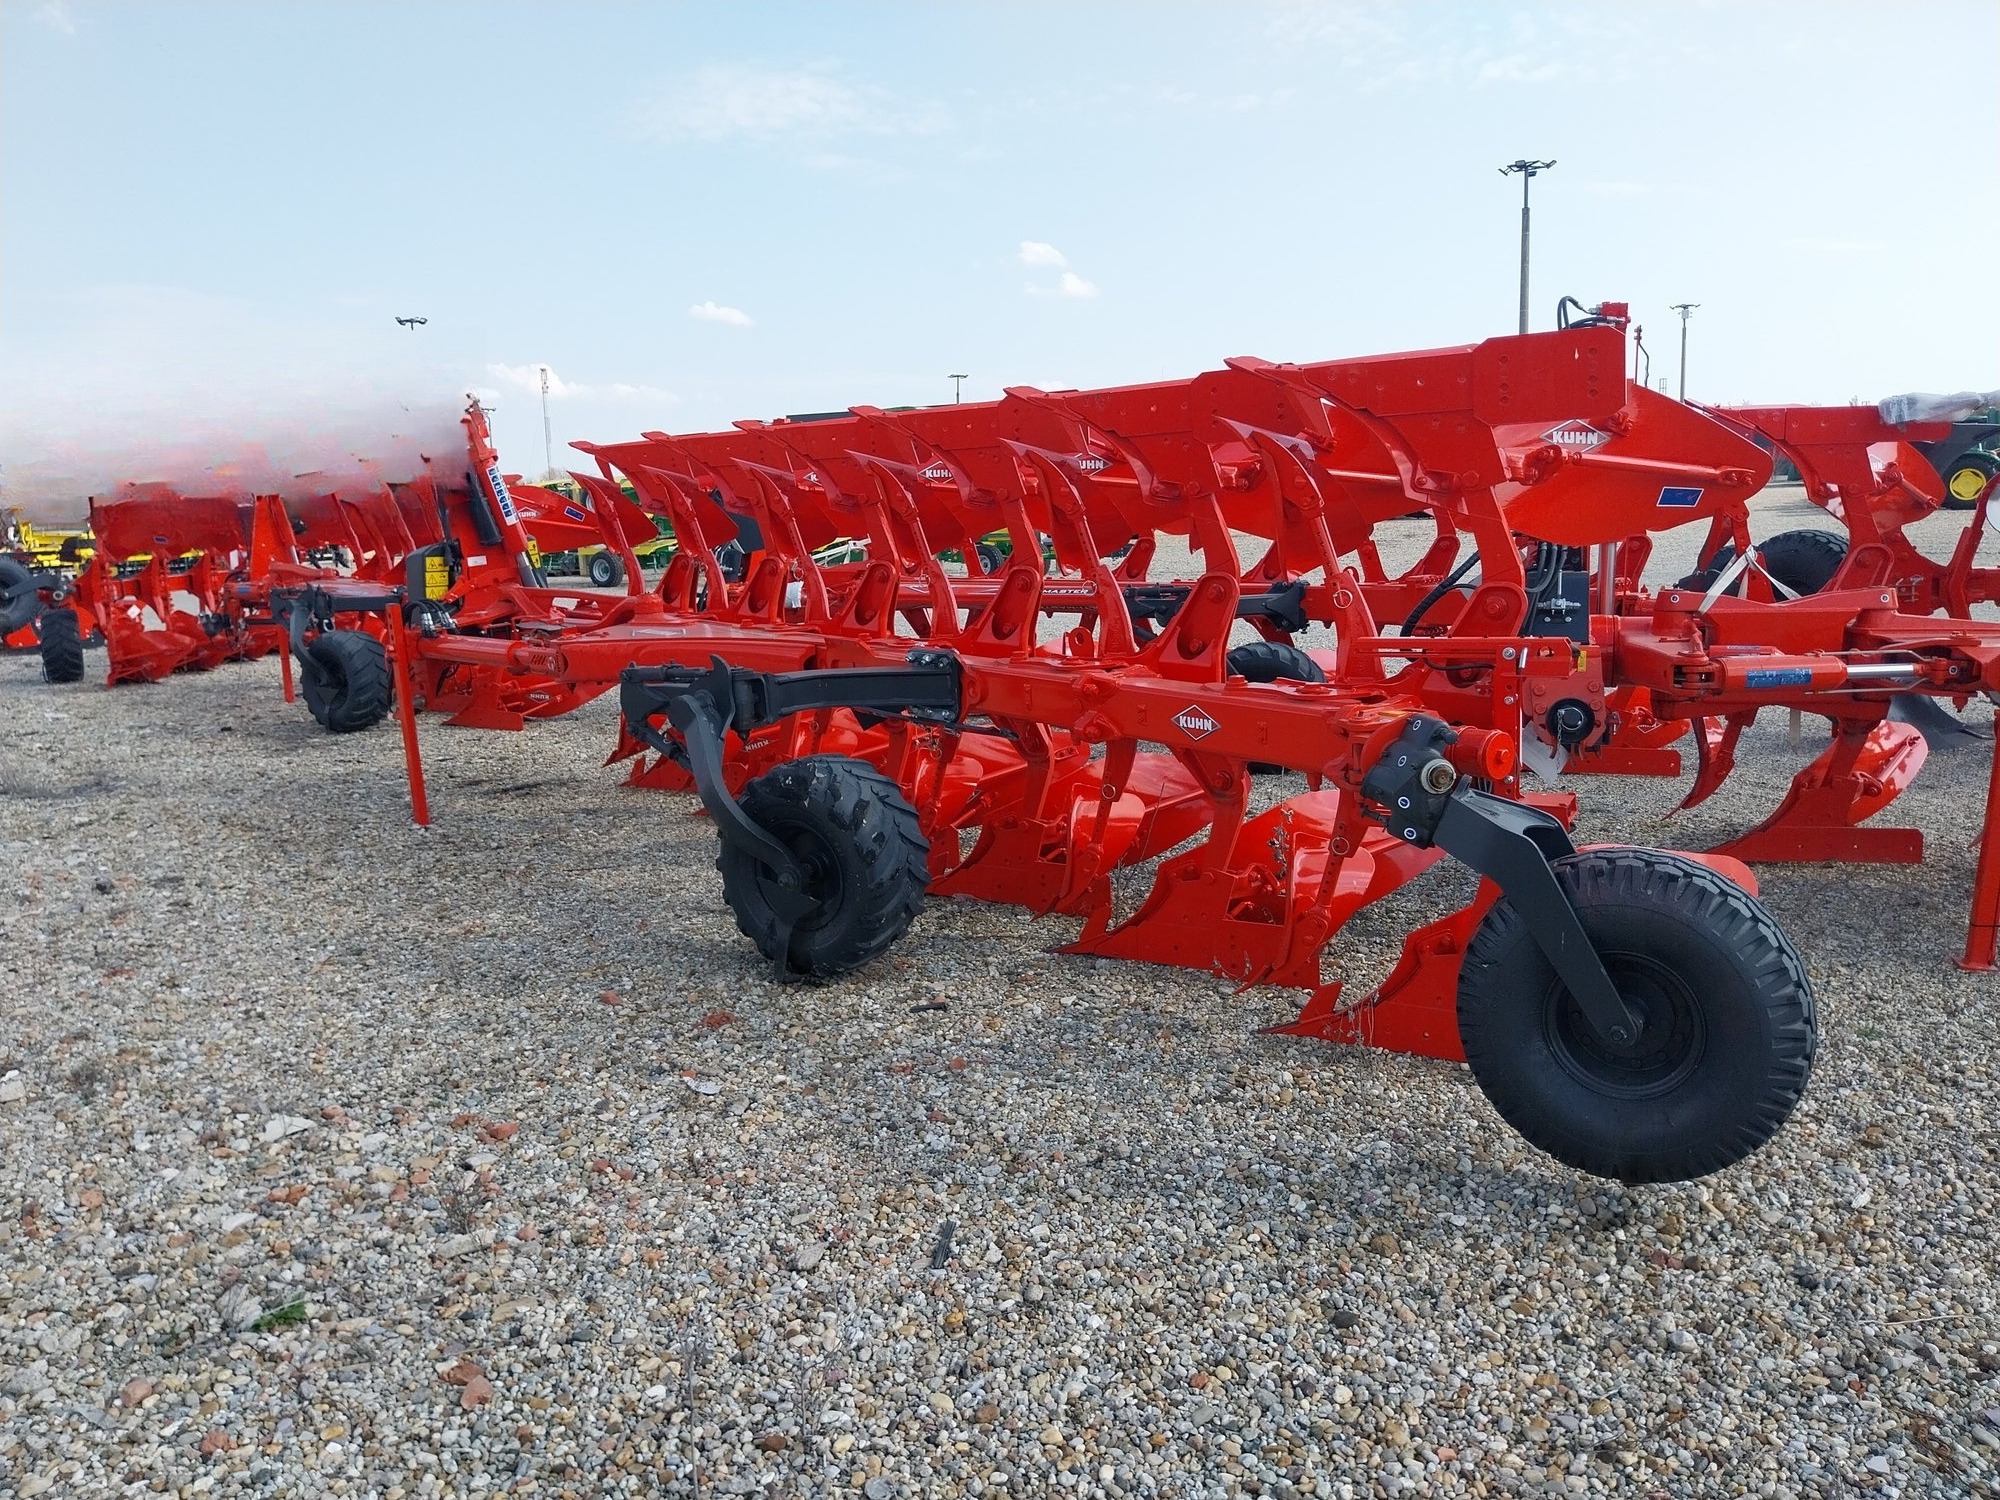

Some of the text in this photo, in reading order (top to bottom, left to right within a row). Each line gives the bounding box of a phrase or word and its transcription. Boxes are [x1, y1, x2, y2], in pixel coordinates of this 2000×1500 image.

[1552, 431, 1598, 444] KUHN
[1080, 460, 1104, 469] UHN
[925, 469, 952, 478] KUH
[1179, 715, 1212, 731] KUHN
[745, 740, 769, 751] KUHN
